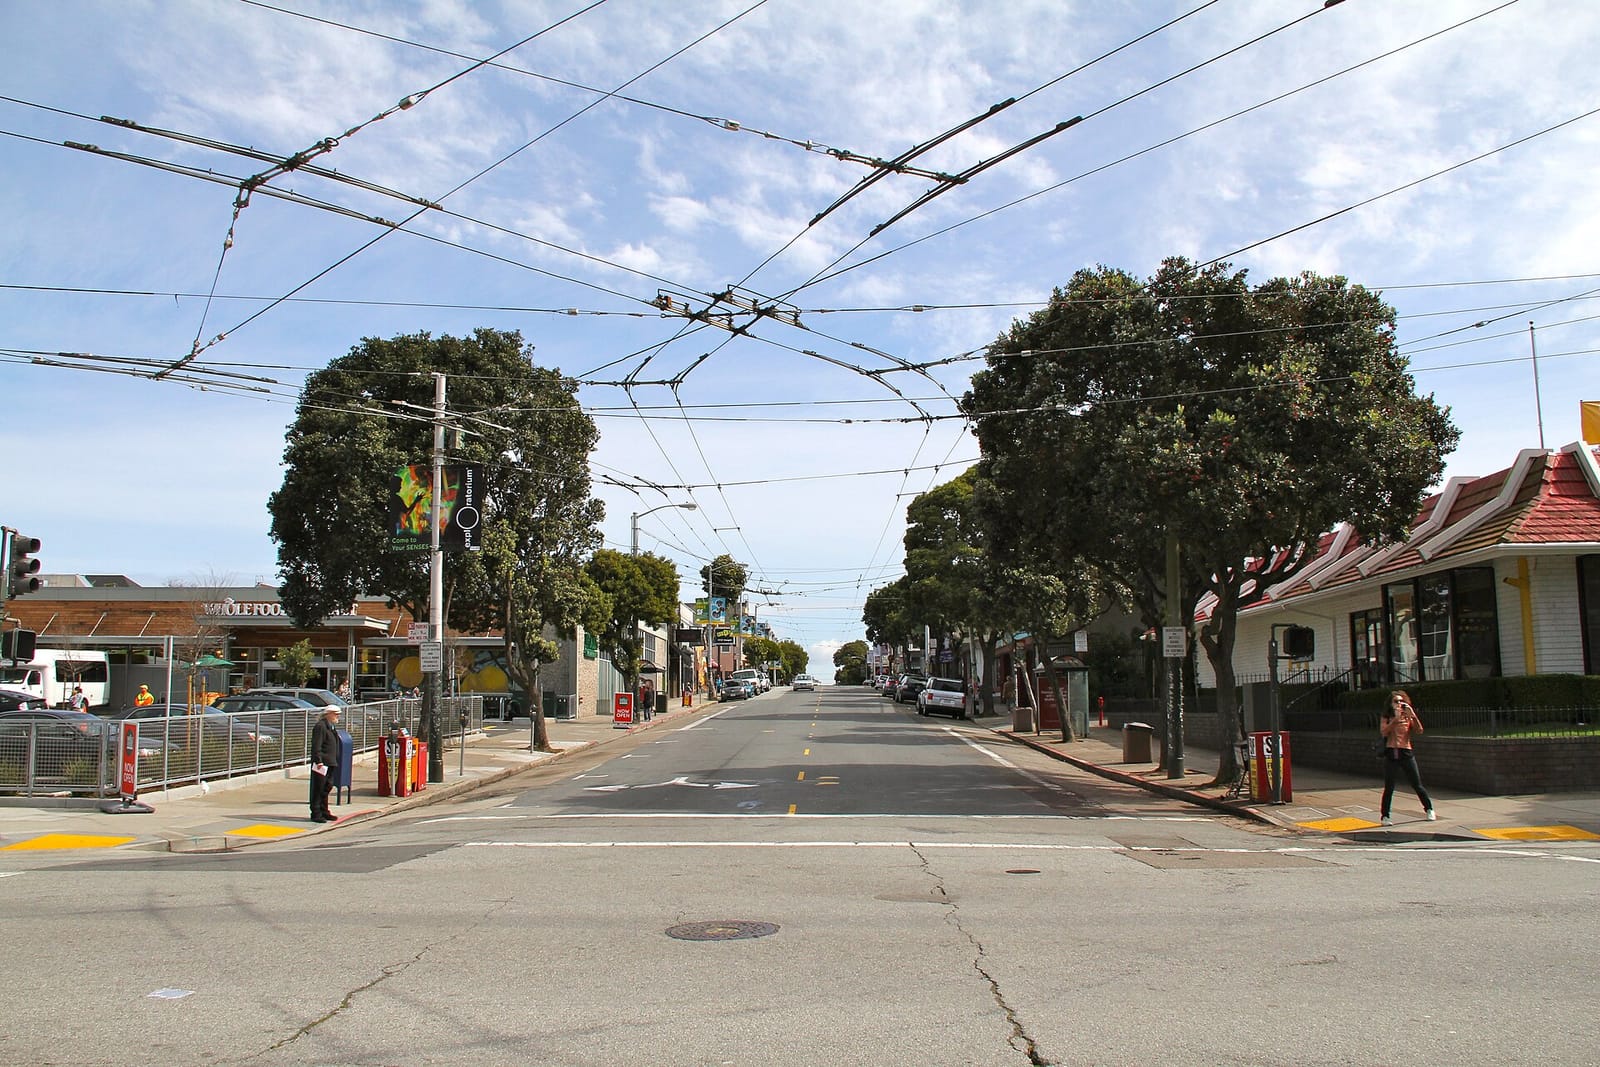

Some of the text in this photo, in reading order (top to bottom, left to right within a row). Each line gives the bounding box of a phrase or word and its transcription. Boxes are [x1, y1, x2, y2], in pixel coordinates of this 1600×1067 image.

[203, 598, 287, 616] WHOLE FOO
[124, 762, 134, 773] NOW
[123, 773, 133, 783] OPEN
